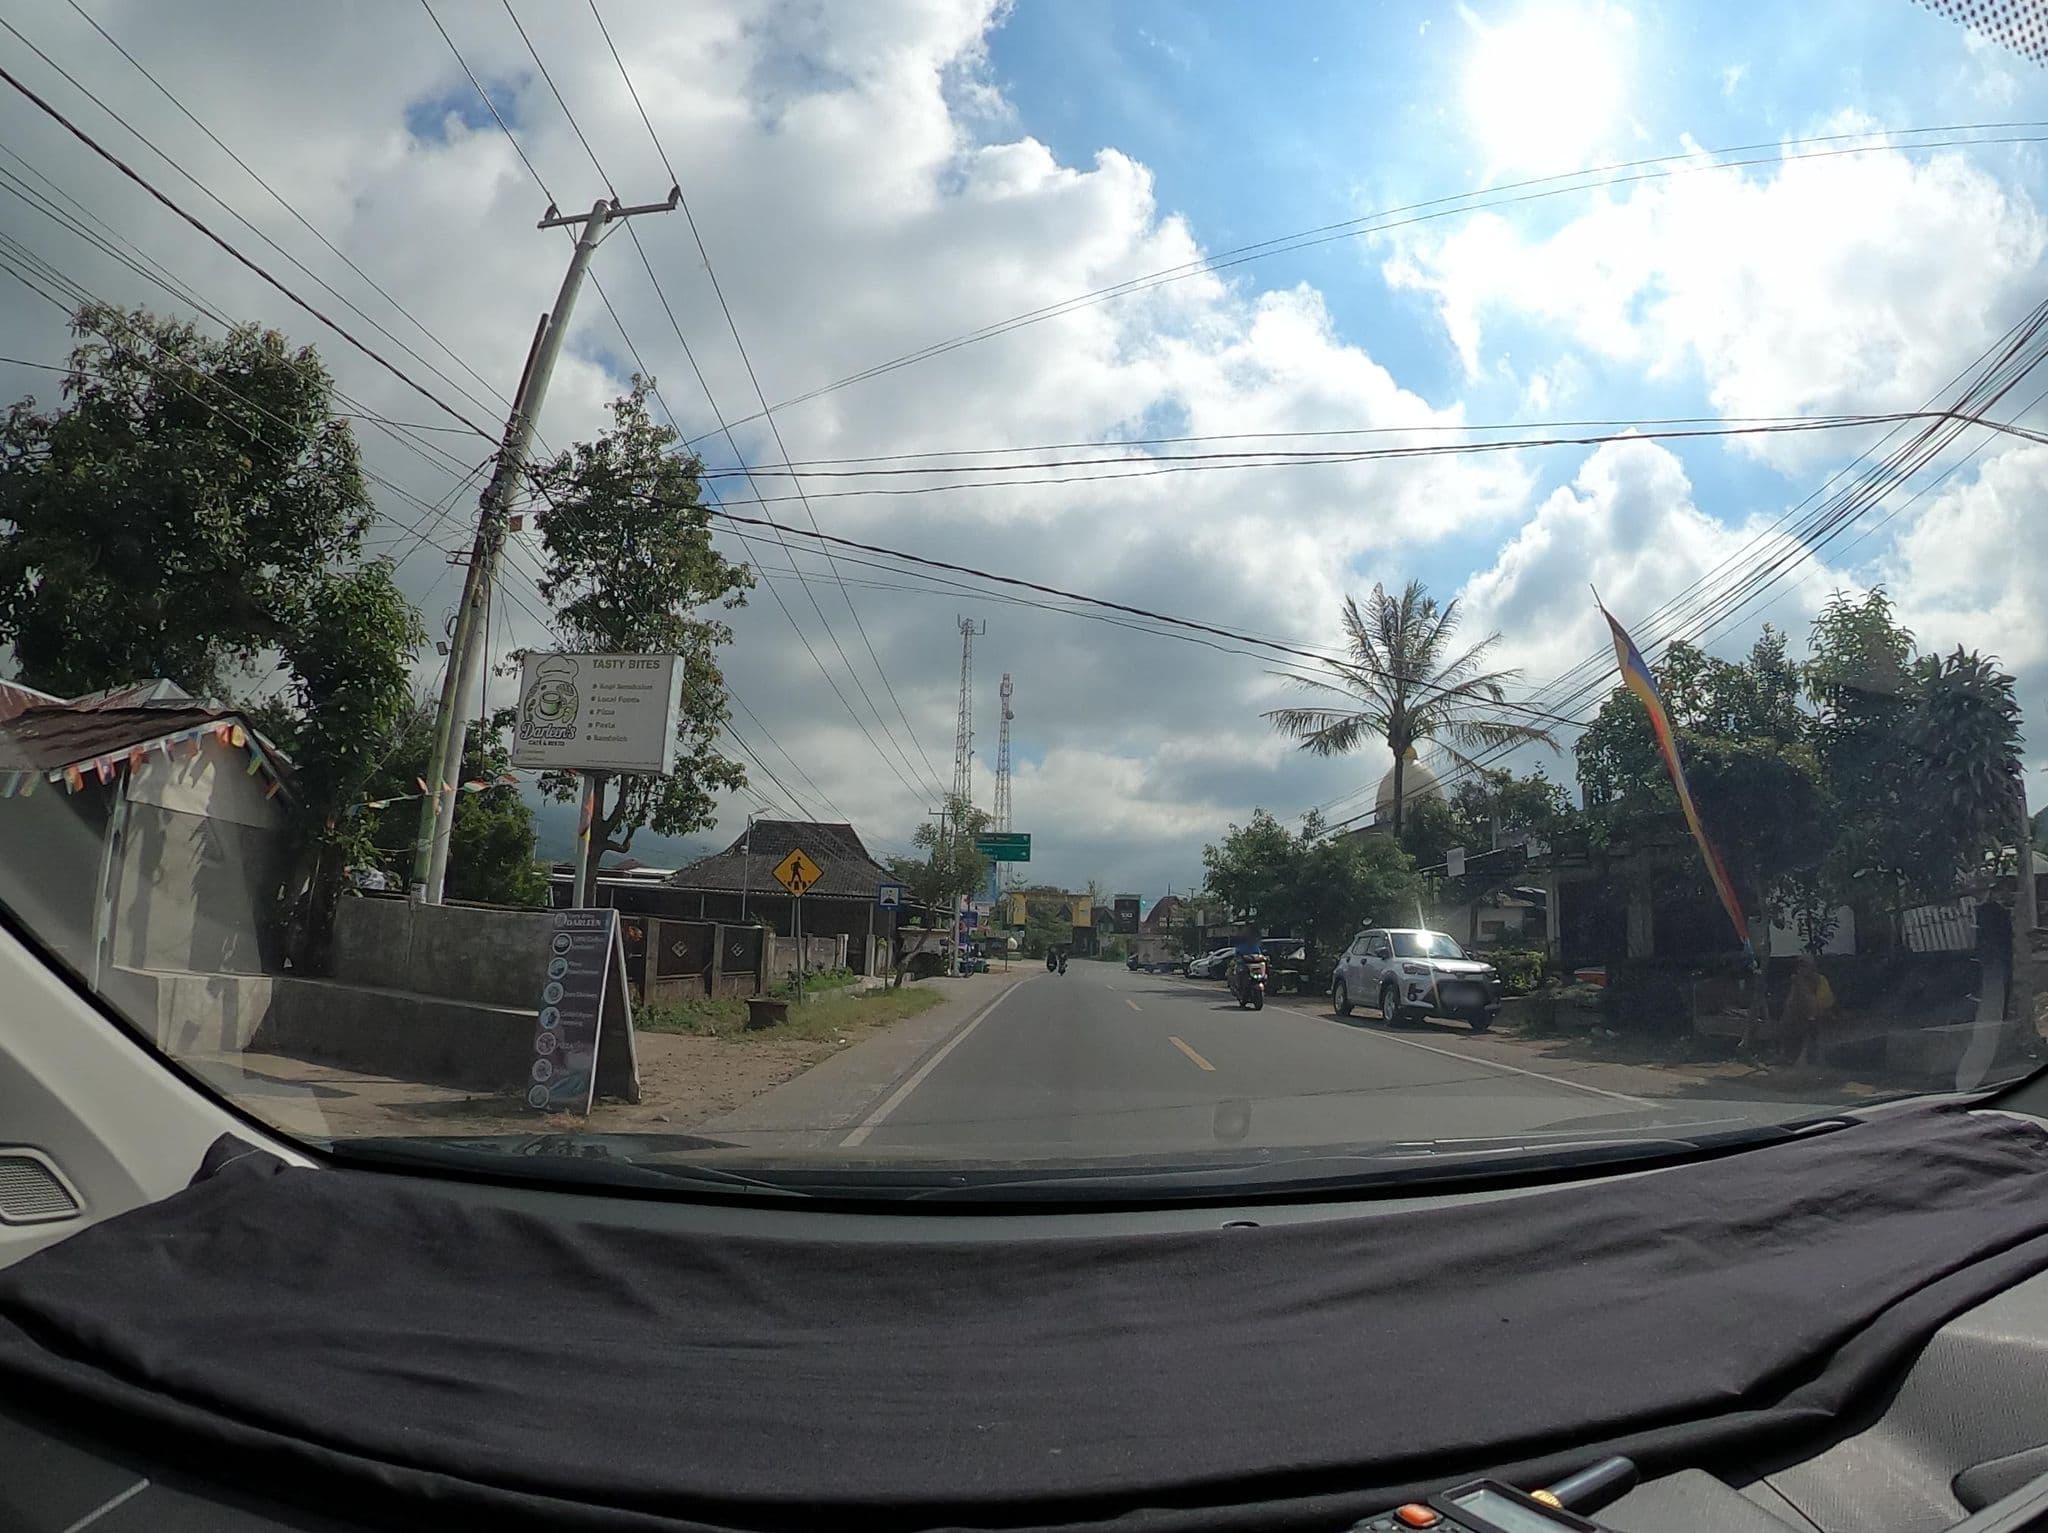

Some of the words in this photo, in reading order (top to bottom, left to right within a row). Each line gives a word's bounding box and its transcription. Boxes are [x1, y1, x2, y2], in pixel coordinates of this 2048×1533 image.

[592, 659, 626, 670] TASTY
[628, 659, 661, 670] BITES
[520, 719, 577, 741] Darleen's
